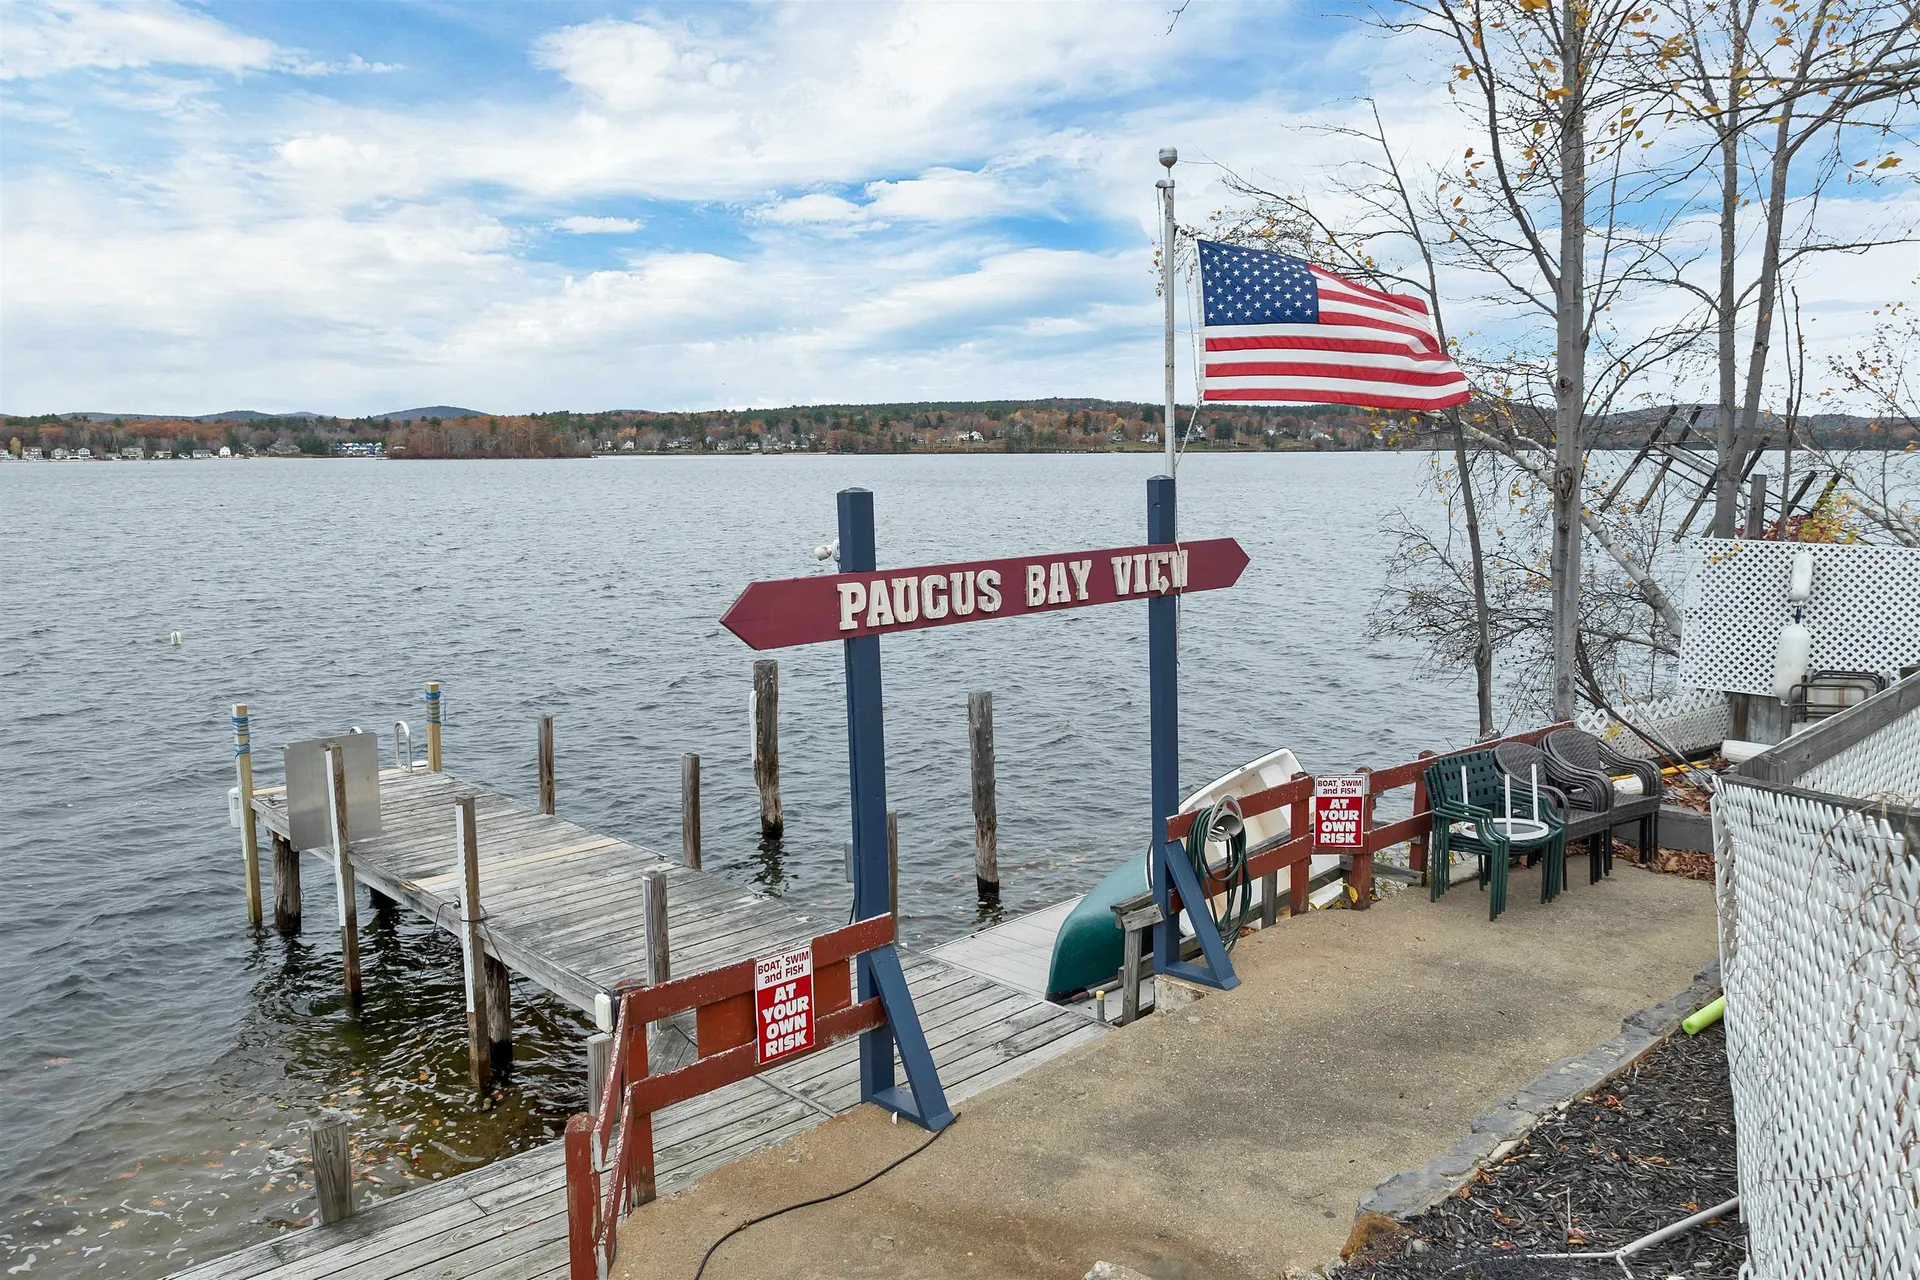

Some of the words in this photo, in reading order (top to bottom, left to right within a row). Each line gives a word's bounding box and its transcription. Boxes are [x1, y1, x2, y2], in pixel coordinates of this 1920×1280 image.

[837, 569, 1002, 631] PAUGUS
[1025, 559, 1092, 607] BAY
[1111, 549, 1188, 595] VIEW
[1330, 798, 1349, 809] AT
[1319, 810, 1359, 820] YOUR
[1322, 822, 1356, 832] OWN
[1320, 833, 1356, 844] RISK
[785, 951, 809, 966] SWIM
[764, 970, 782, 984] and
[785, 964, 804, 977] FISH
[774, 982, 797, 1004] AT
[762, 995, 810, 1024] YOUR
[766, 1012, 807, 1040] OWN
[766, 1029, 808, 1058] RISK
